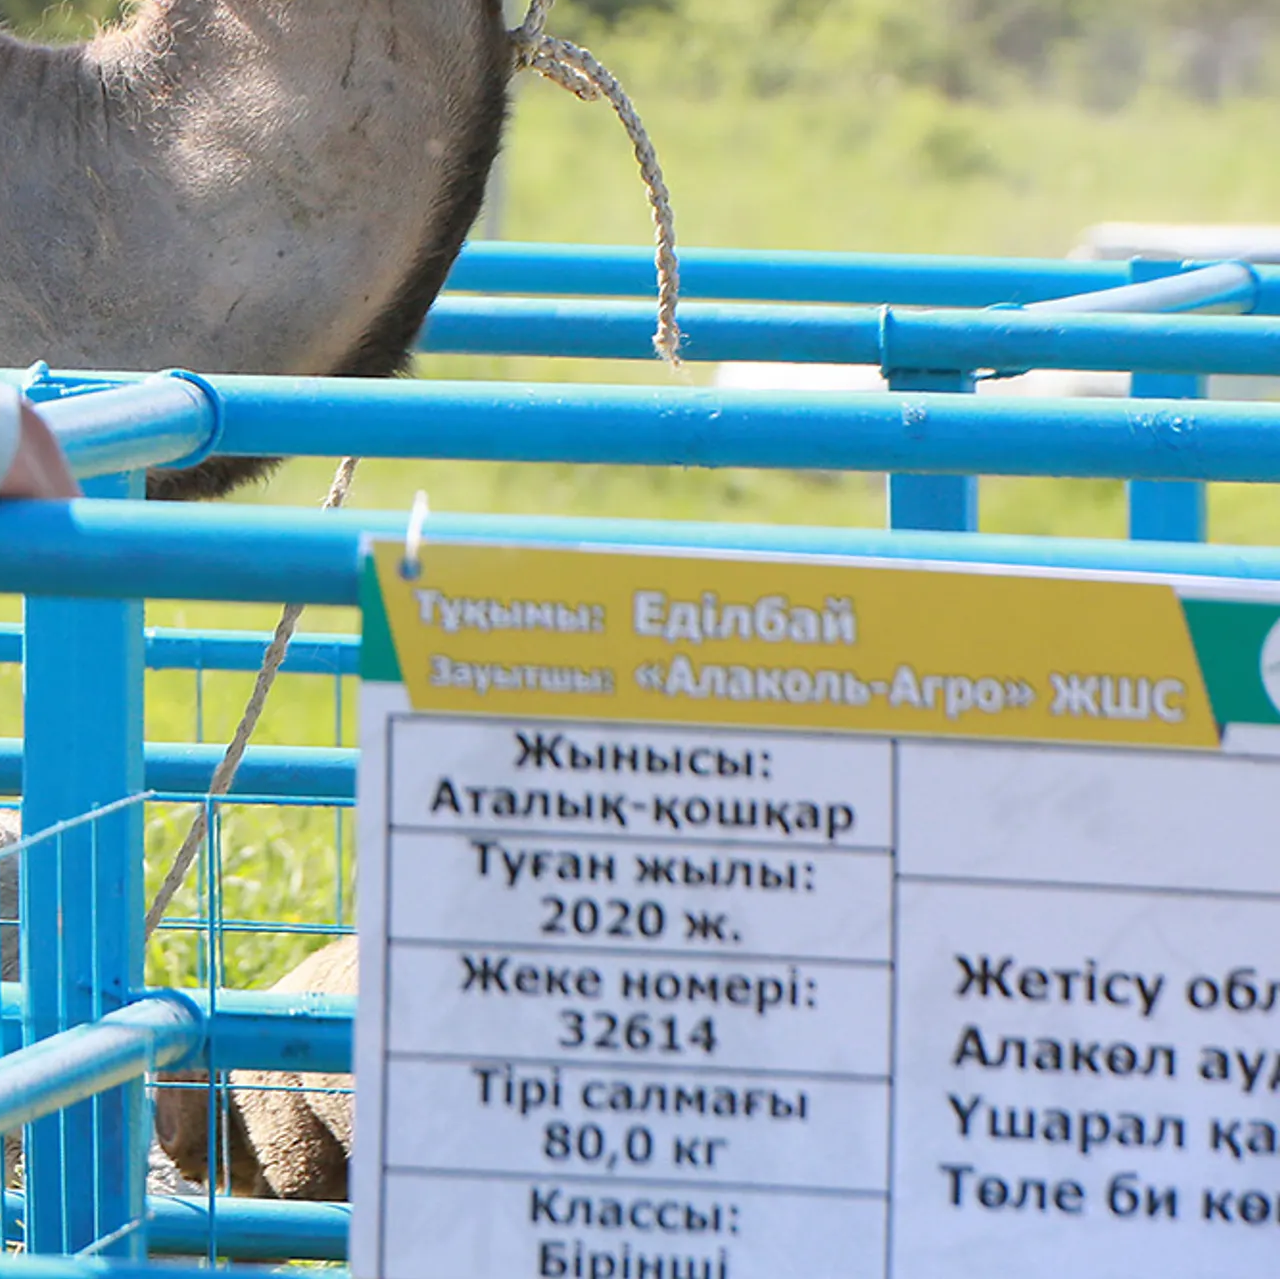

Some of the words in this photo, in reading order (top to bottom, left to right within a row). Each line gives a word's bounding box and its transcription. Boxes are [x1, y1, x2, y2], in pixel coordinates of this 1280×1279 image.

[633, 589, 858, 646] Еділбай
[635, 656, 1037, 719] «Алаколь-Агро»
[1051, 673, 1187, 723] ЖШС
[514, 732, 773, 778] Жынысы:
[429, 778, 855, 840] Аталық-қошқар
[469, 839, 617, 888] Туған
[635, 856, 817, 891] жылы:
[540, 899, 665, 938] 2020
[684, 911, 742, 944] ж.
[460, 954, 603, 998] Жеке
[621, 966, 818, 1014] номері:
[954, 953, 1165, 1017] Жетісу
[558, 1010, 719, 1054] 32614
[951, 1022, 1176, 1076] Алакөл
[473, 1065, 562, 1116] Тірі
[581, 1077, 808, 1120] салмағы
[542, 1123, 654, 1169] 80,0
[674, 1136, 728, 1166] кг
[947, 1092, 1185, 1154] Үшарал
[1210, 1118, 1278, 1160] қа
[529, 1188, 741, 1233] Классы:
[938, 1161, 1086, 1214] Төле
[1107, 1171, 1177, 1218] би
[1202, 1189, 1280, 1224] кө
[539, 1241, 729, 1279] Бірінші
